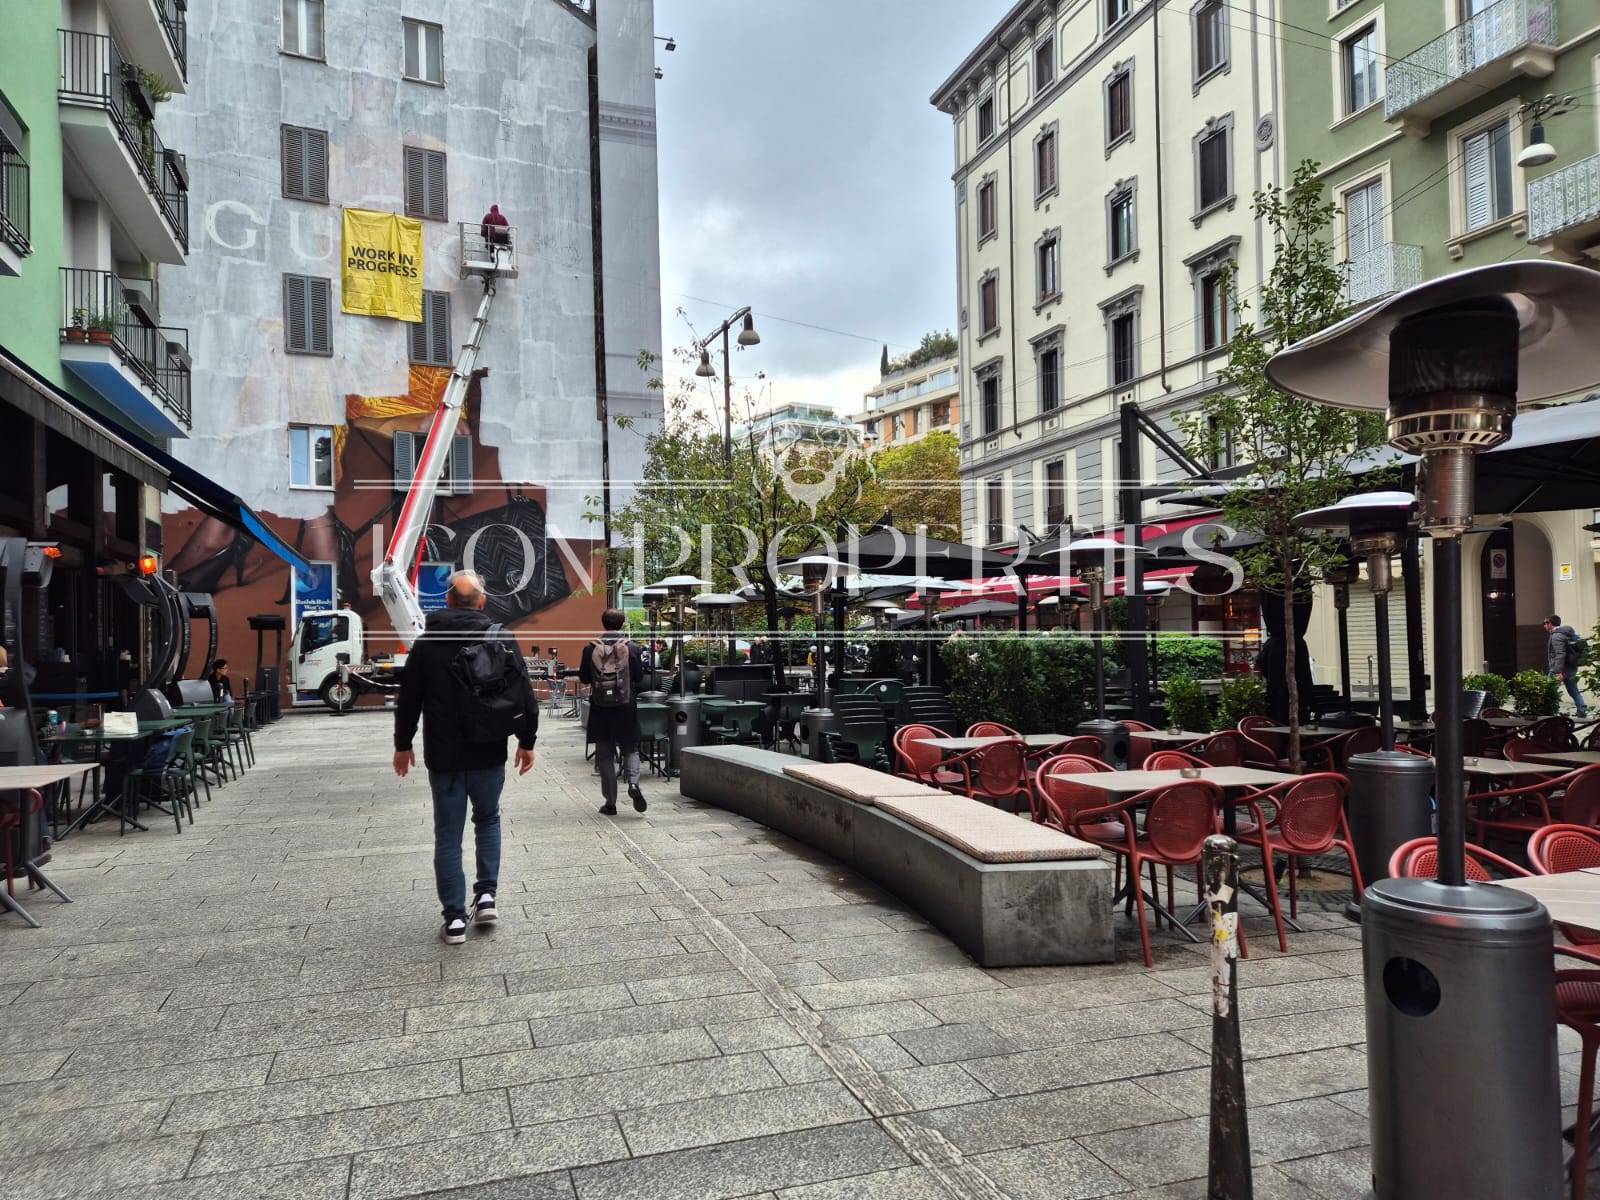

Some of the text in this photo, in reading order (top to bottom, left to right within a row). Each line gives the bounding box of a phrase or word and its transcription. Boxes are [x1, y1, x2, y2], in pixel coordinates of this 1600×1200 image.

[352, 246, 414, 266] WORK IN
[347, 257, 418, 278] PROGRESS
